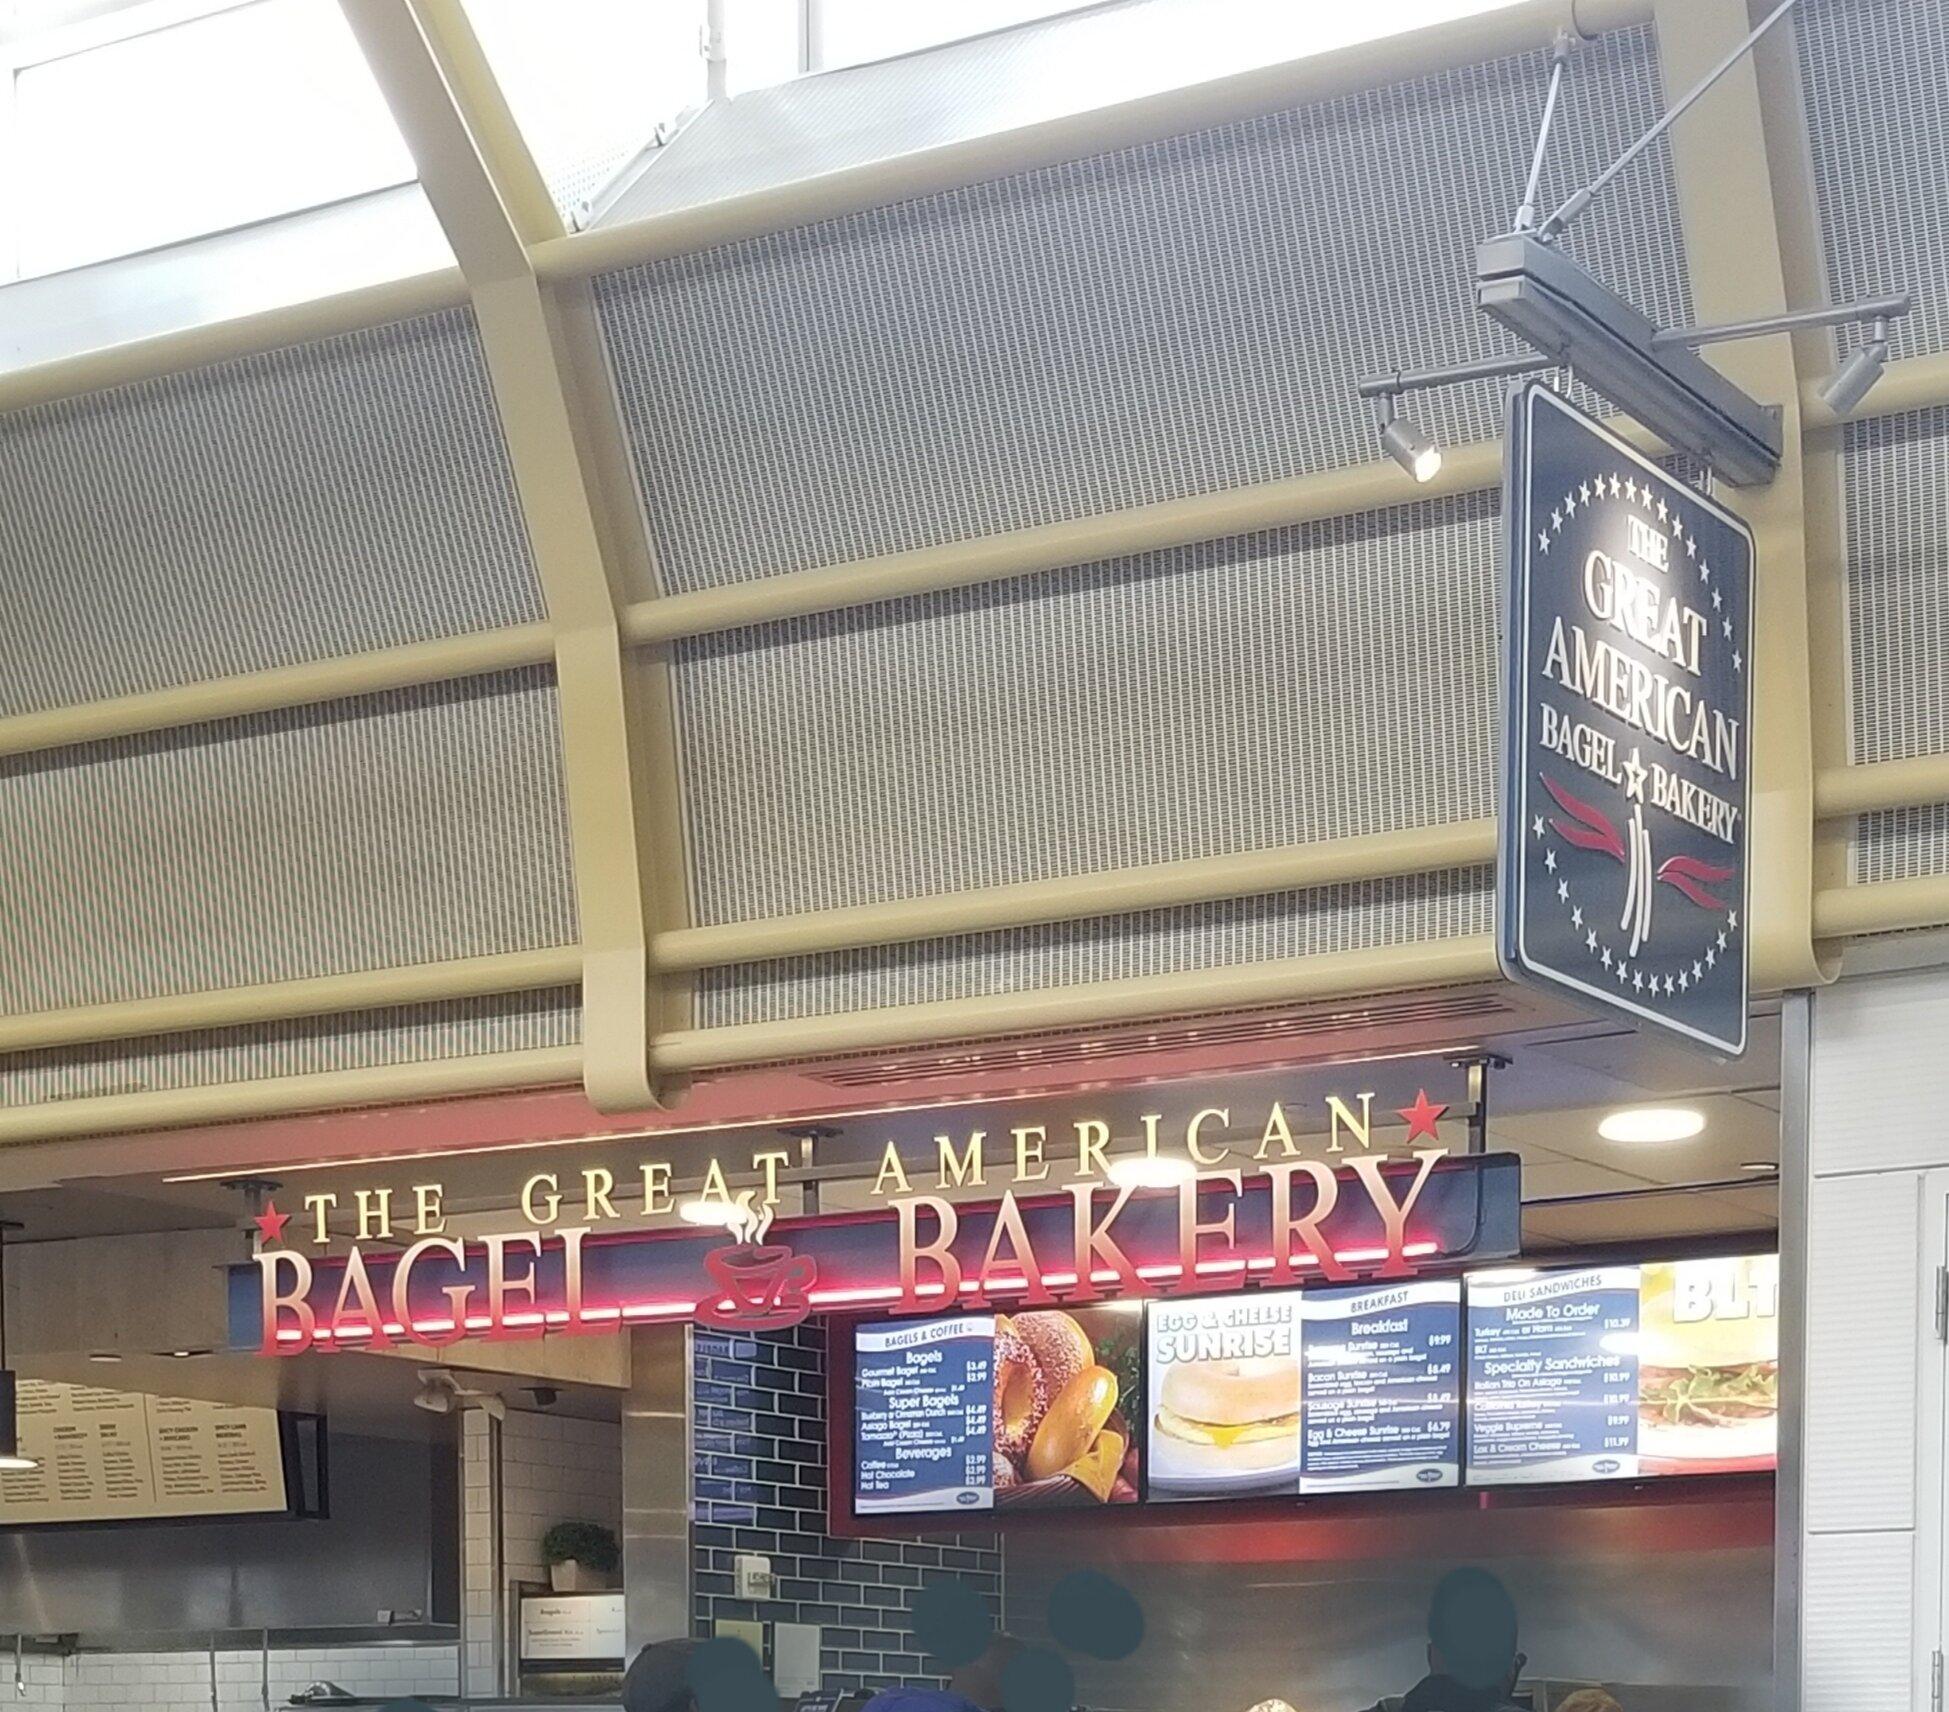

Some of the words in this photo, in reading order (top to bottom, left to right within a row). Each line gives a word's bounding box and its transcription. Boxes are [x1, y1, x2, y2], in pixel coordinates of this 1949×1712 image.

[1627, 515, 1669, 574] THE
[1584, 548, 1708, 677] GREAT
[1541, 615, 1739, 782] AMERICAN
[1539, 702, 1623, 786] BAGEL
[1650, 762, 1738, 846] BAKERY
[305, 1184, 446, 1244] THE
[521, 1151, 789, 1225] GREAT
[870, 1092, 1375, 1195] AMERICAN
[253, 1226, 624, 1358] BAGEL
[888, 1148, 1448, 1315] BAKERY
[1350, 1290, 1409, 1313] BREAKFAST
[1503, 1292, 1526, 1303] DELI
[1530, 1274, 1602, 1299] SANDWICHES
[1672, 1264, 1778, 1324] BLT
[1157, 1312, 1198, 1332] EGG
[1223, 1304, 1292, 1328] CHEESE
[1506, 1307, 1544, 1321] Made
[1546, 1305, 1561, 1317] To
[1563, 1302, 1600, 1317] Order
[885, 1331, 918, 1348] BAGELS
[921, 1330, 927, 1340] &
[930, 1323, 964, 1338] COFFEE
[1351, 1318, 1408, 1335] Breakfast
[906, 1350, 943, 1366] Bagels
[1156, 1327, 1291, 1364] SUNRISE
[896, 1365, 919, 1377] Bagel
[1484, 1359, 1542, 1377] Specialty
[1544, 1355, 1621, 1371] Sandwiches
[889, 1396, 921, 1410] Super
[922, 1393, 959, 1409] Bagels
[895, 1447, 952, 1461] Beverages
